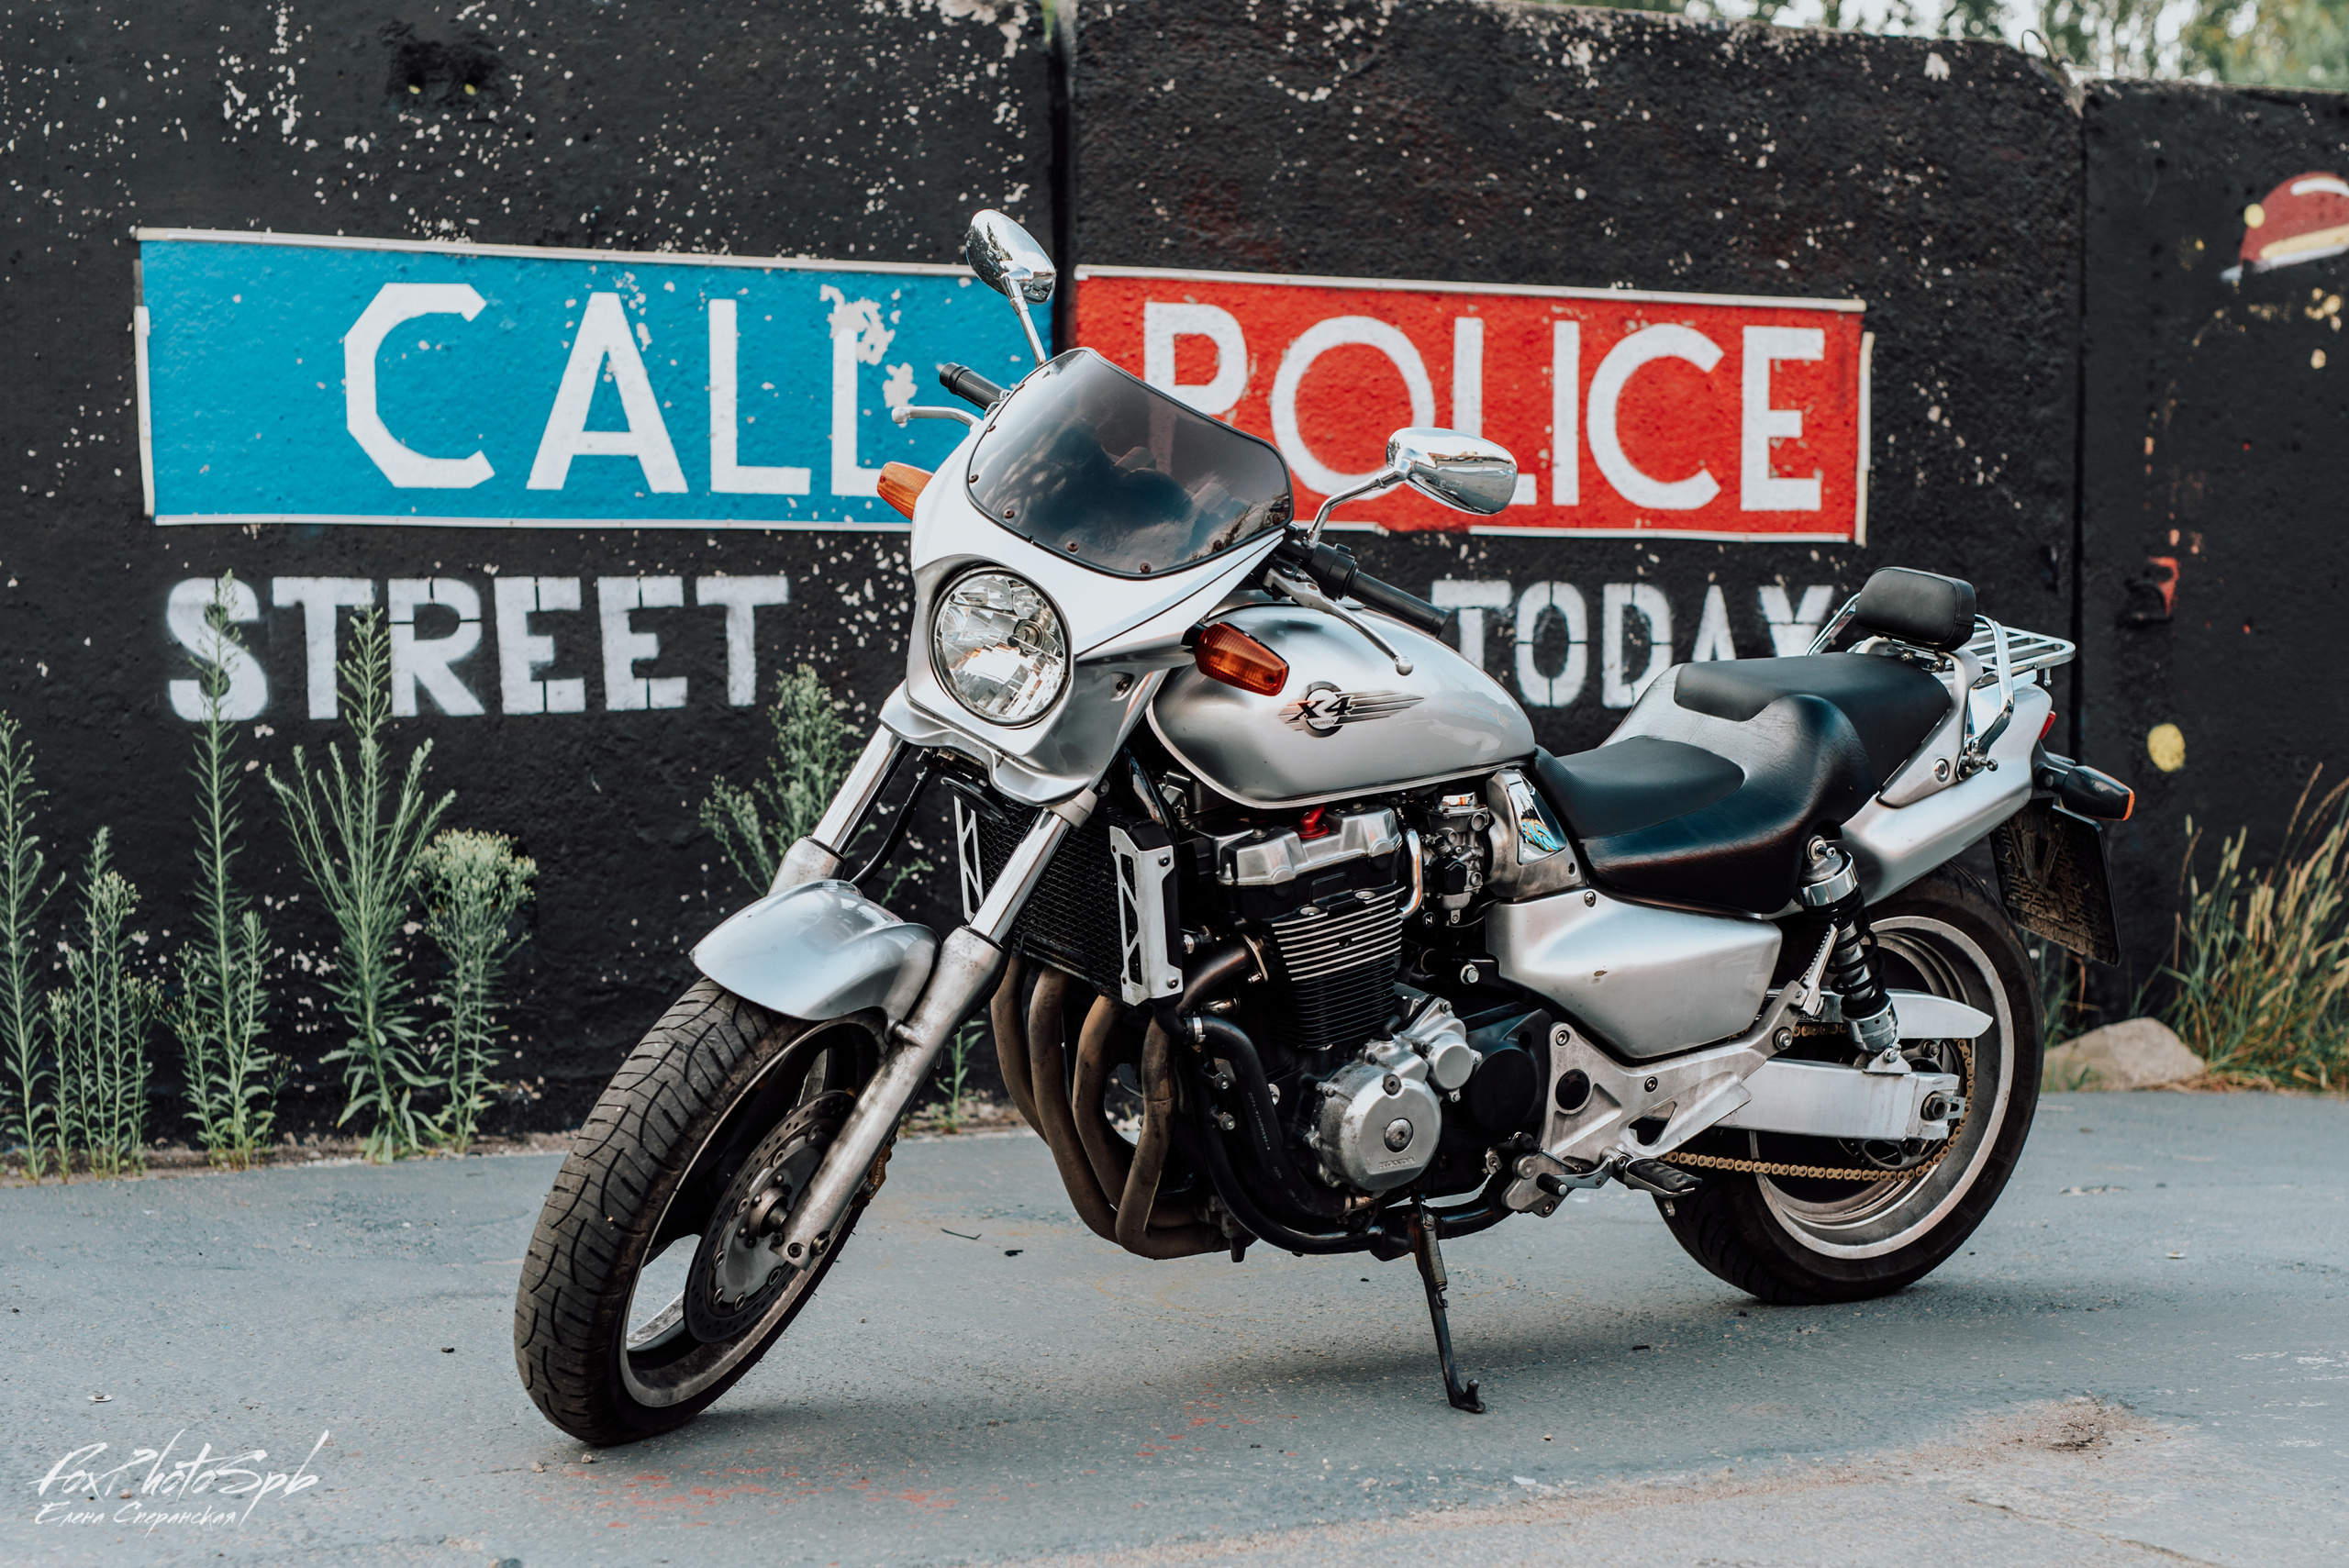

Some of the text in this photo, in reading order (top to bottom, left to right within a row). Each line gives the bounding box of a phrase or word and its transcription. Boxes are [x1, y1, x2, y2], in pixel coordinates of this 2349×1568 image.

[344, 283, 888, 496] CALL
[1144, 302, 1824, 511] POLICE
[167, 574, 789, 721] STREET
[1287, 695, 1353, 722] X4
[1431, 580, 1833, 708] TODAY
[1379, 1156, 1415, 1170] HONDA
